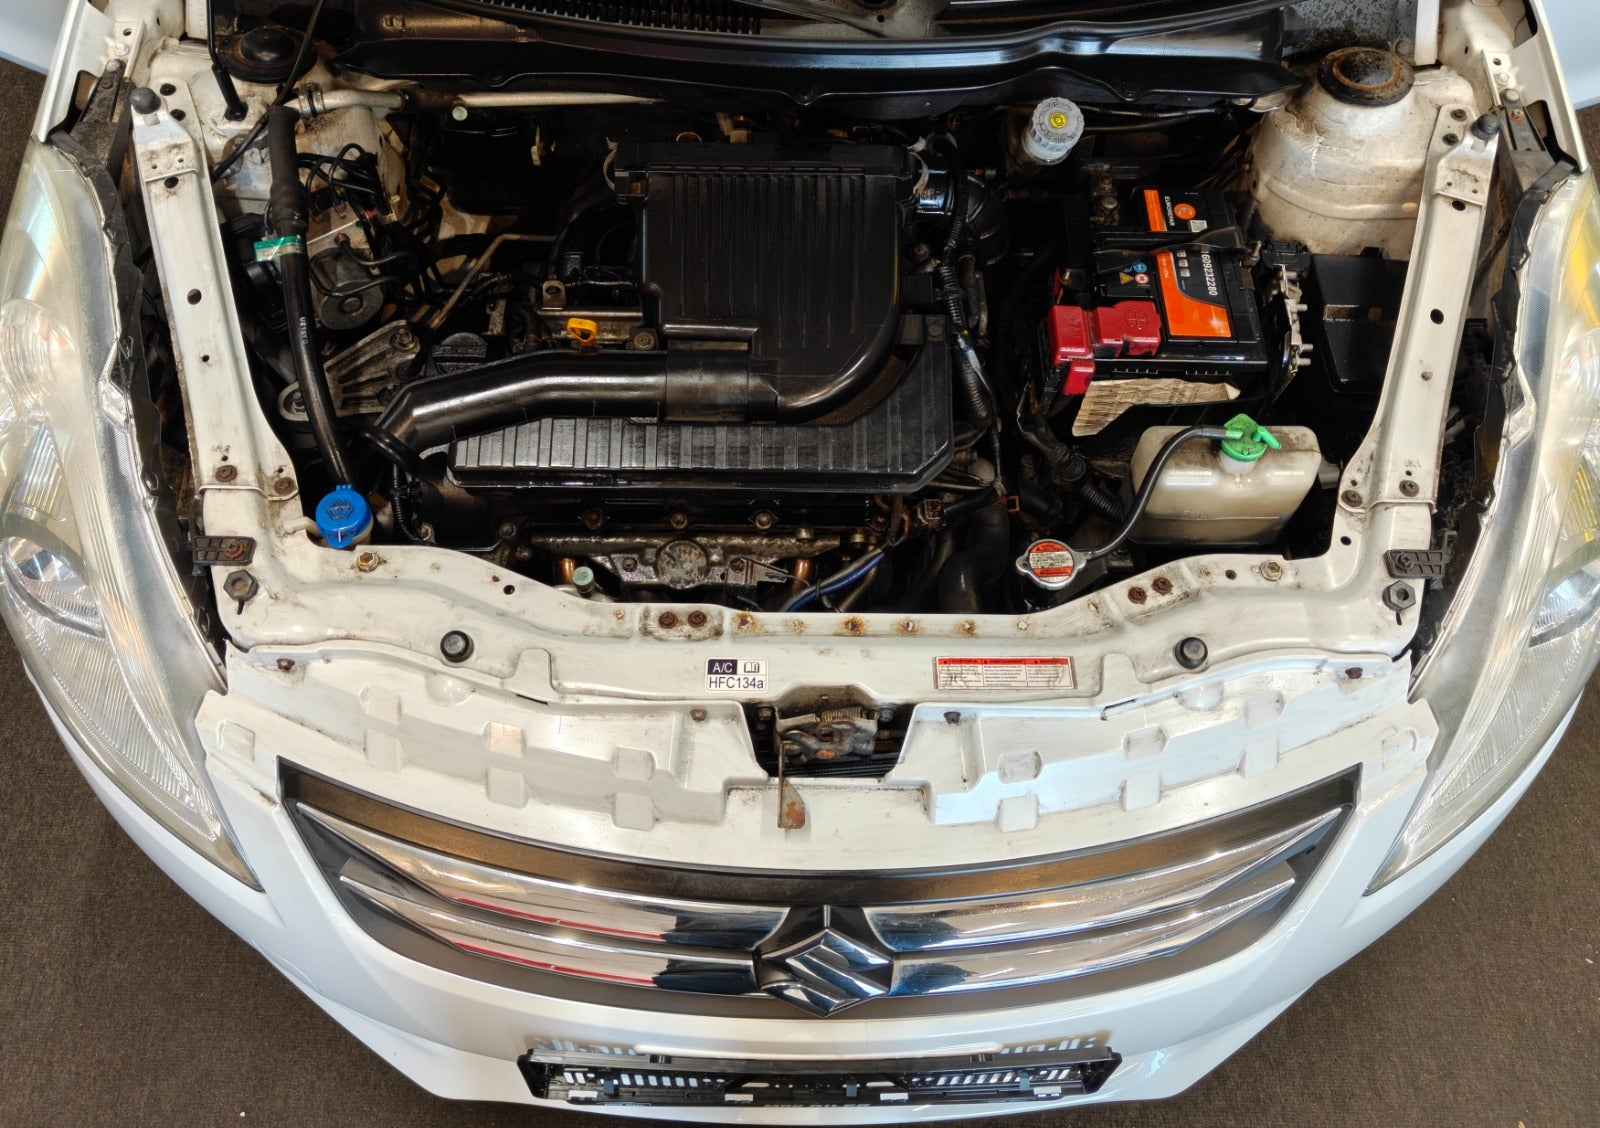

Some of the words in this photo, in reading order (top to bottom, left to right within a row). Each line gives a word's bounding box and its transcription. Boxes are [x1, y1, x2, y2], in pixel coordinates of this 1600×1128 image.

[1200, 251, 1218, 296] 1609232280
[712, 662, 733, 673] A/C
[709, 676, 764, 689] HFC134a
